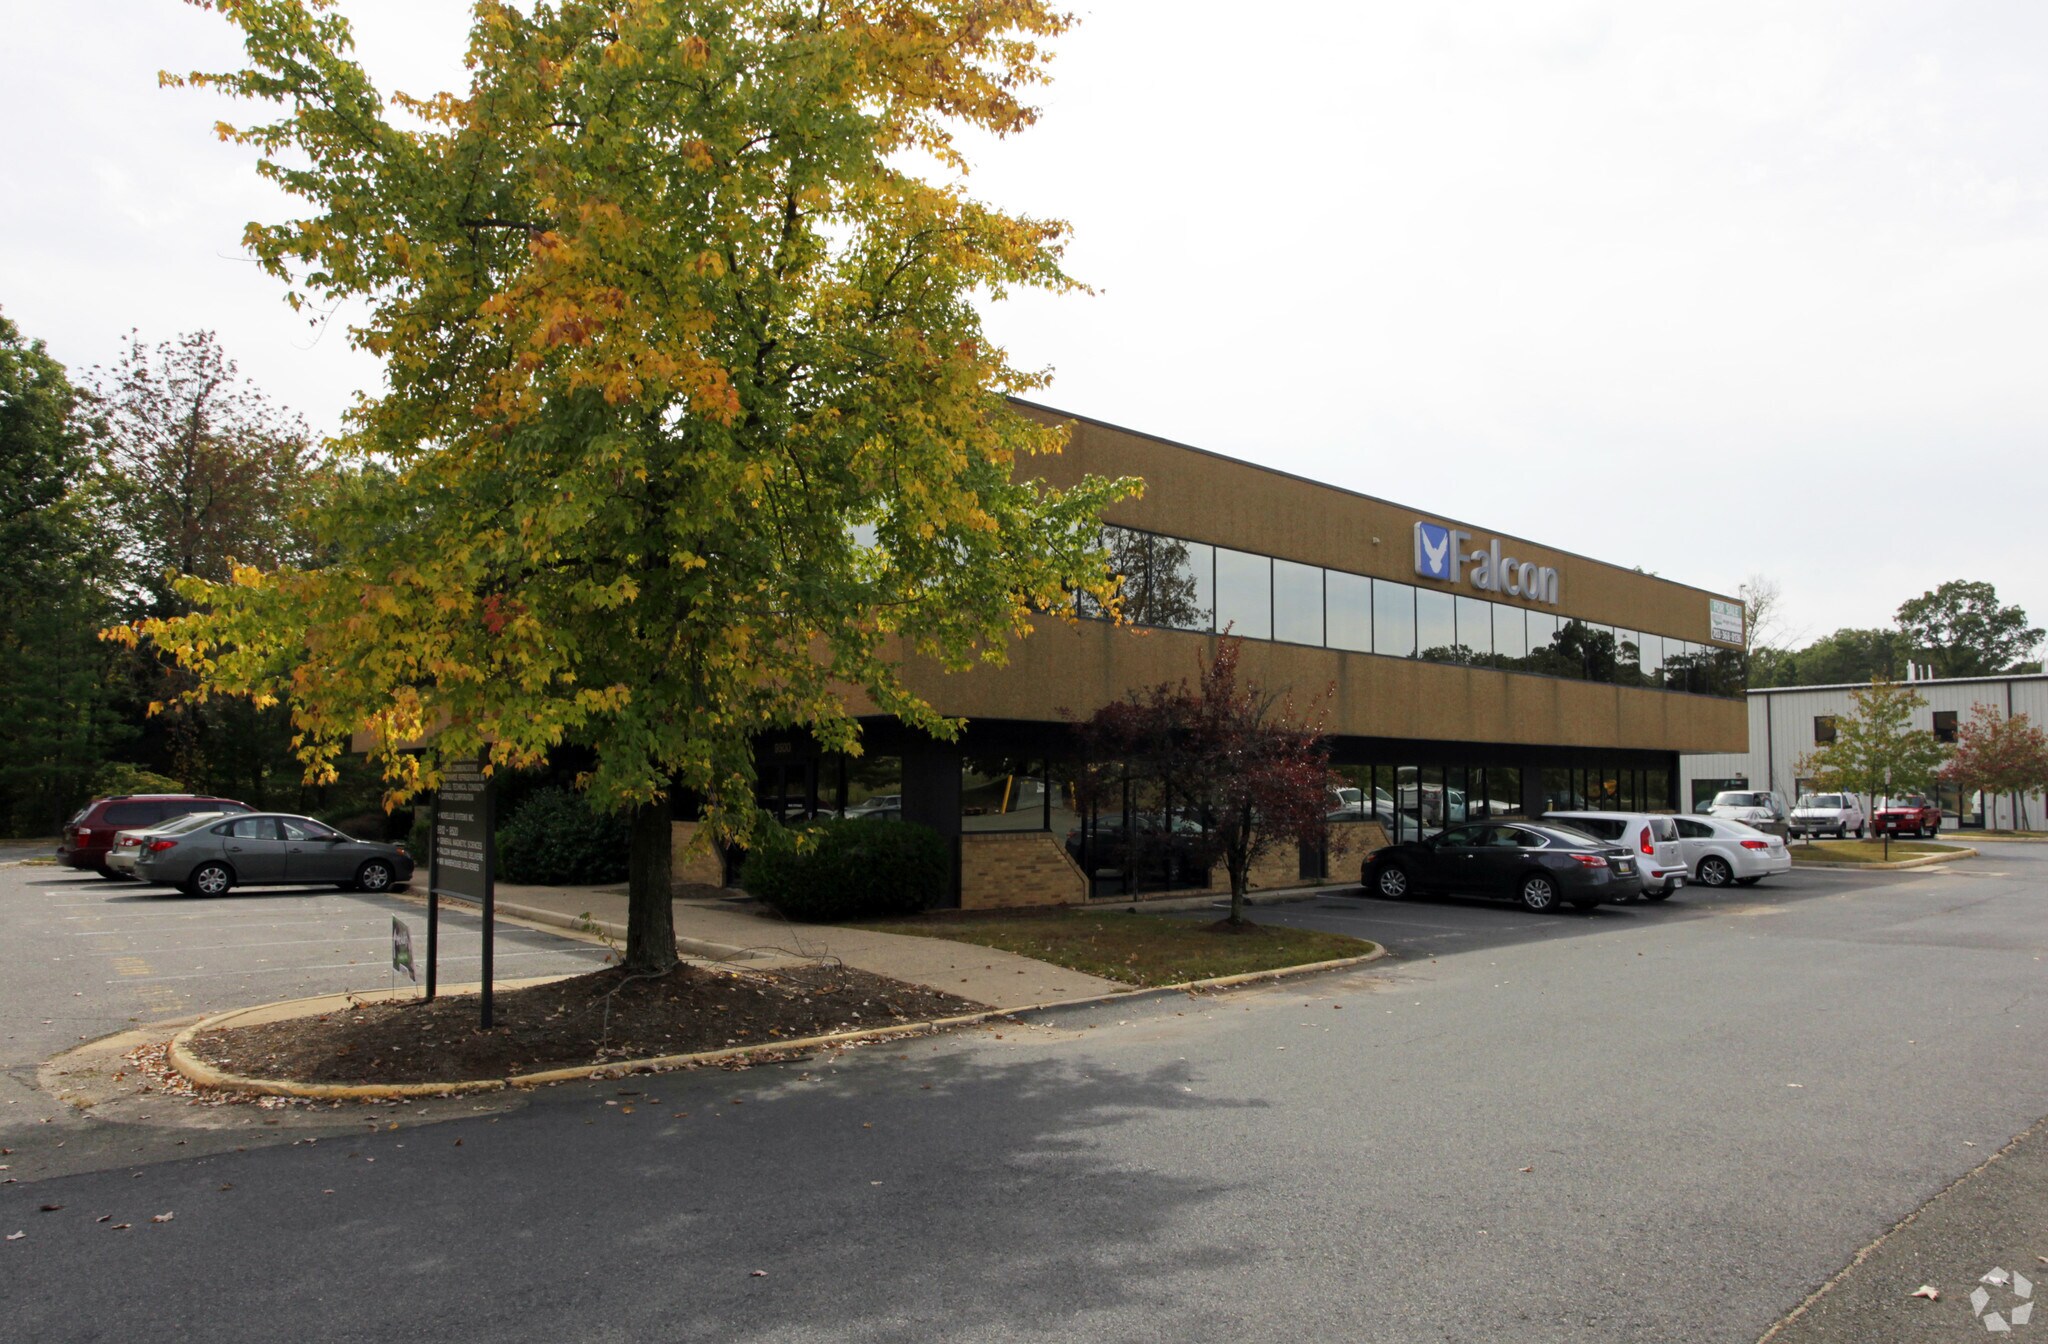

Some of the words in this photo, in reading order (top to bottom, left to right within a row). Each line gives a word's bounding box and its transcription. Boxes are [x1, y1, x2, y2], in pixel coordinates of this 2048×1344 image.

[1450, 529, 1558, 605] Falcon
[1713, 601, 1724, 614] FOR
[1726, 604, 1739, 617] SALE
